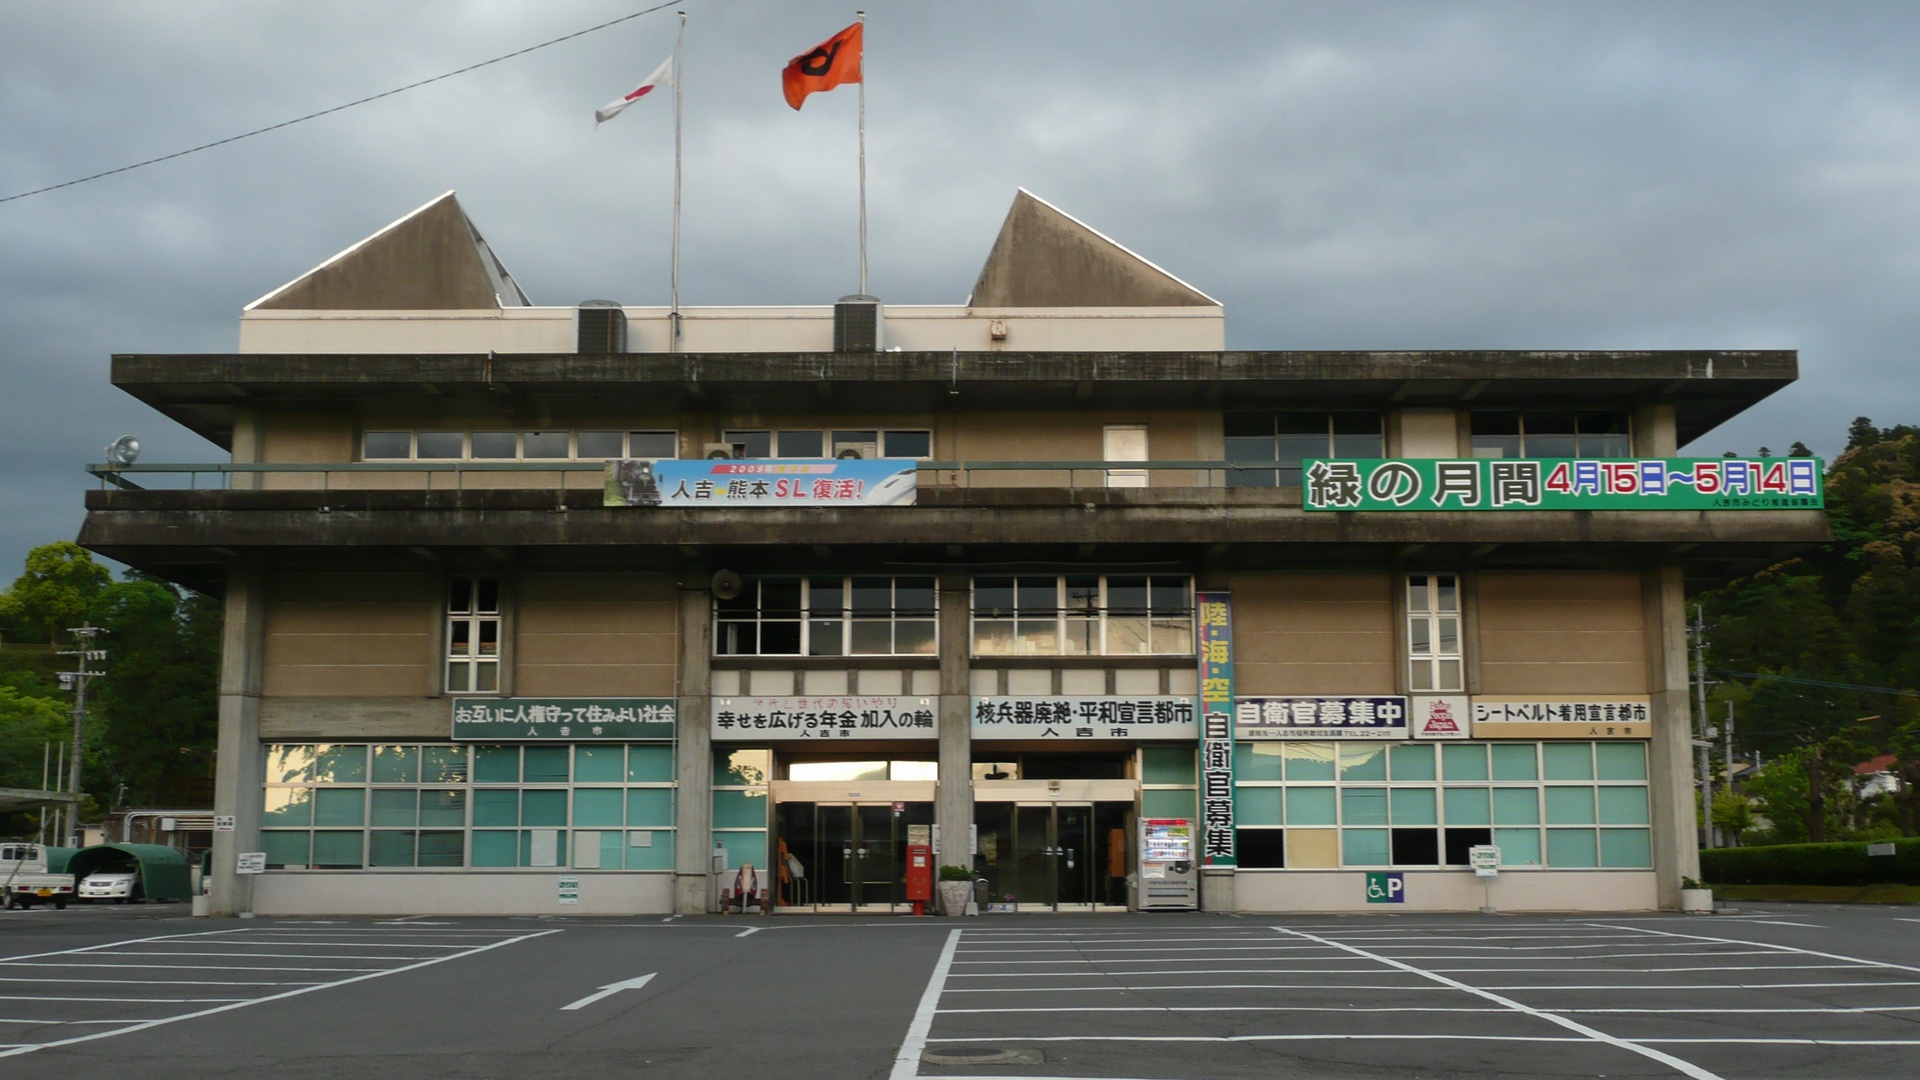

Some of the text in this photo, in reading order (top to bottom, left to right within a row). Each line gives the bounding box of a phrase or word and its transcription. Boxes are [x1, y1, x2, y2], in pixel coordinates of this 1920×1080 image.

[1307, 460, 1541, 507] 緑の月間
[455, 704, 676, 723] お互いに人権守って住みよい社会
[717, 710, 934, 729] 幸せを広げる年金加入の輪
[975, 701, 1193, 724] 核兵器廃絶・平和宣言都市
[1236, 701, 1402, 725] 自衛官募集中
[1477, 704, 1646, 722] シートベルト着用宣言都市
[800, 729, 850, 738] 人吉市
[1041, 728, 1129, 737] 人吉市
[1204, 713, 1234, 857] 自衛官募集
[1387, 878, 1402, 898] P
